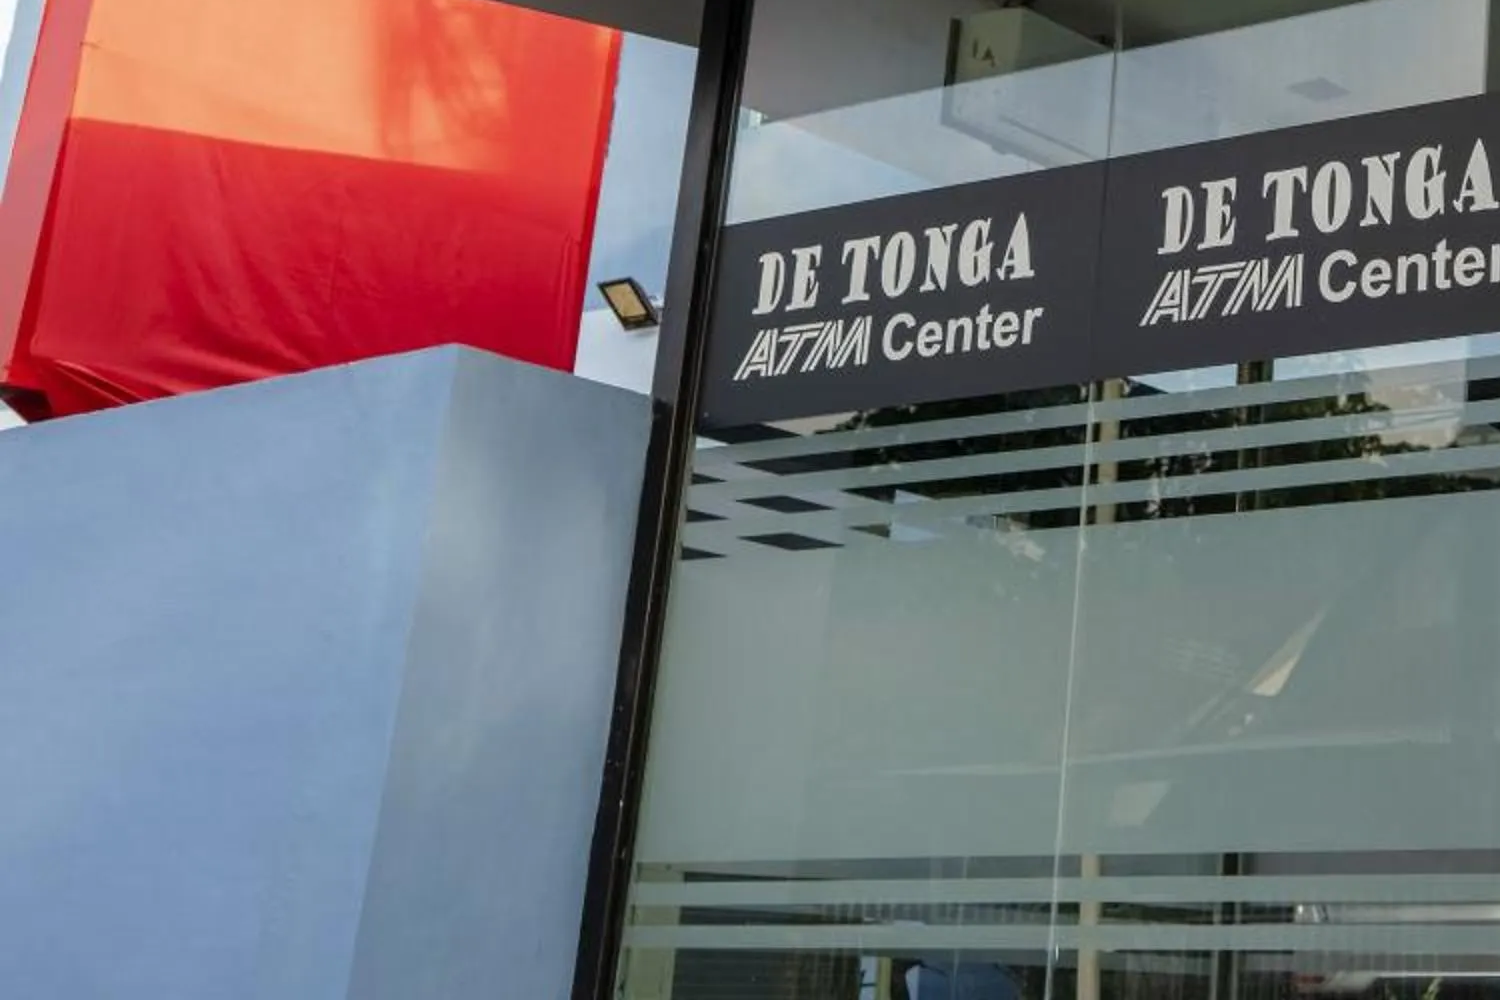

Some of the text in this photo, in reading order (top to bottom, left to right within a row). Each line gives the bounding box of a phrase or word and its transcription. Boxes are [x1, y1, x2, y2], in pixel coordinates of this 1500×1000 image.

[1157, 138, 1500, 256] DE TONGA
[751, 212, 1036, 316] DE TONGA
[1139, 253, 1304, 328] ATM
[733, 302, 1044, 382] ATM Center
